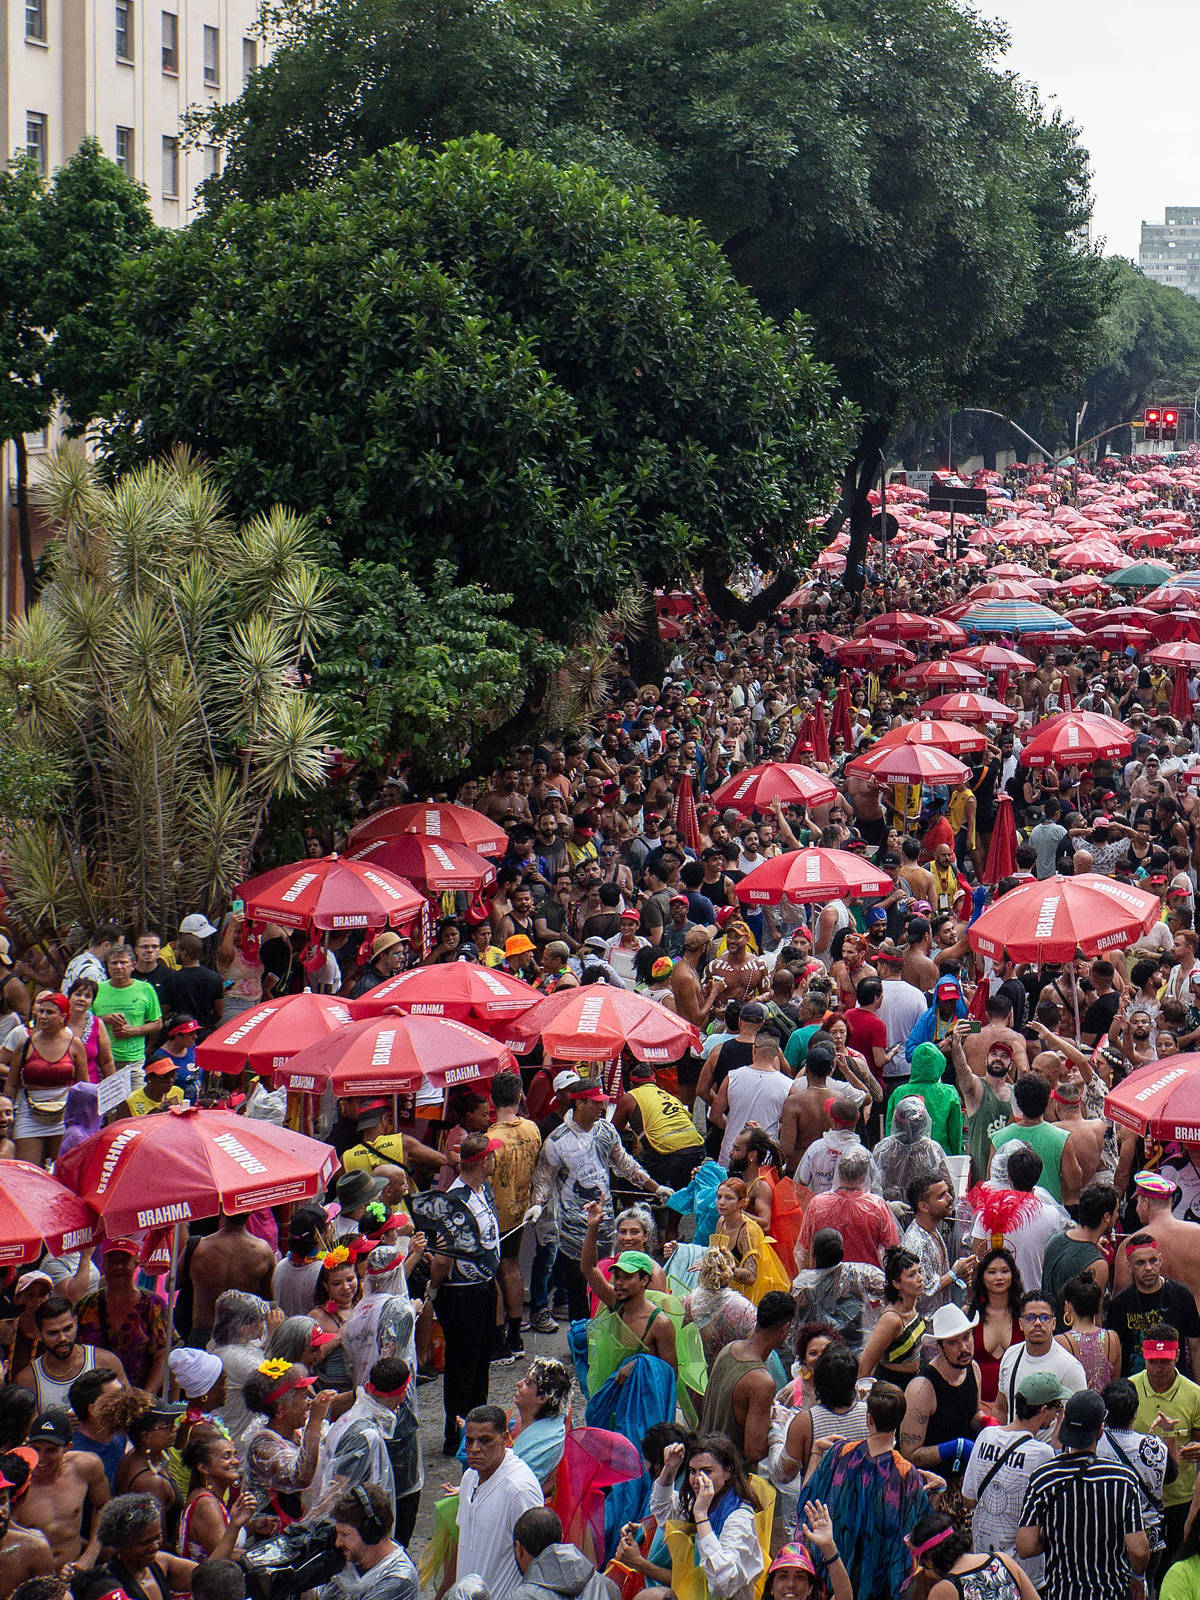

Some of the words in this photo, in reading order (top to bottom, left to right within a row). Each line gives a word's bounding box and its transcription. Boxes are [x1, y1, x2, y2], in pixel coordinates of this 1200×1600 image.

[281, 872, 319, 902] BRAHMA
[363, 870, 404, 900] BRAHMA
[333, 914, 368, 928] BRAHMA
[1034, 896, 1061, 938] BRAHMA
[1097, 931, 1129, 950] BRAHMA
[411, 1003, 445, 1017] BRAHMA
[223, 1006, 281, 1046] BRAHMA
[372, 1028, 397, 1067] BRAHMA
[643, 1047, 670, 1059] BRAHMA
[289, 1074, 316, 1089] BRAHMA
[443, 1064, 481, 1085] BRAHMA
[1134, 1068, 1189, 1102] BRAHMA
[96, 1128, 143, 1195] BRAHMA
[213, 1131, 269, 1176] BRAHMA
[137, 1201, 192, 1229] BRAHMA
[62, 1225, 94, 1252] BRAHMA
